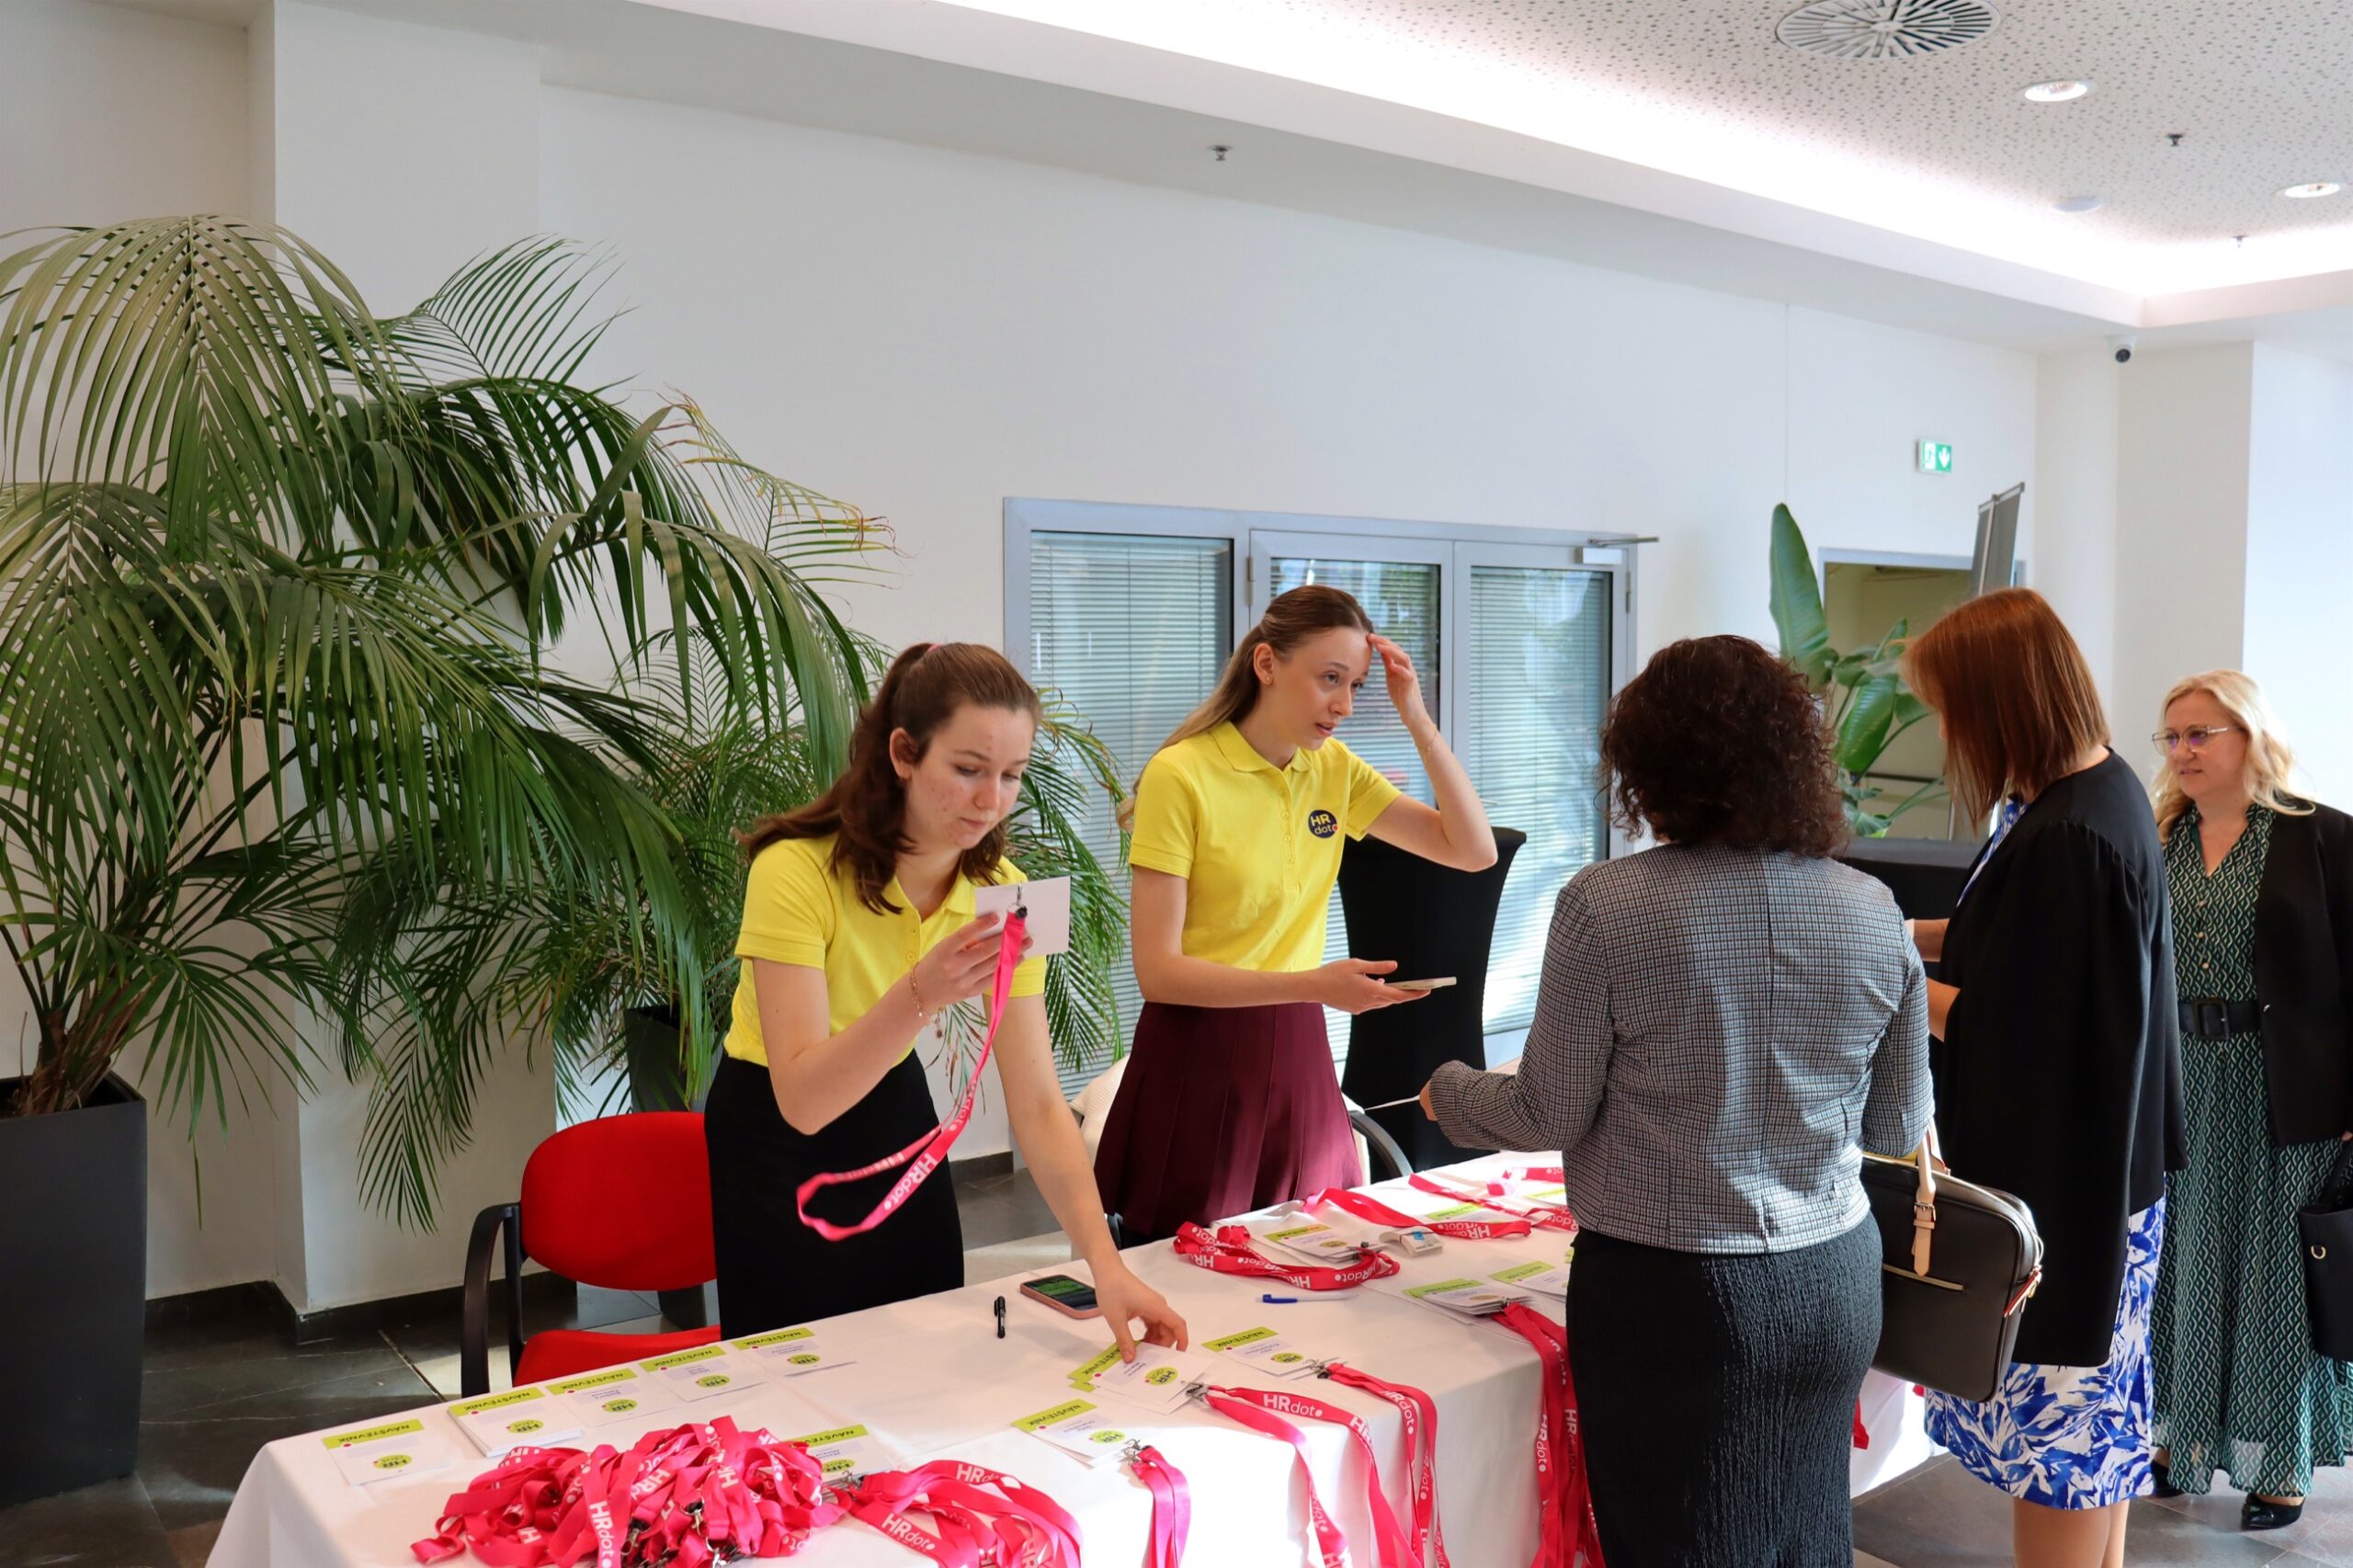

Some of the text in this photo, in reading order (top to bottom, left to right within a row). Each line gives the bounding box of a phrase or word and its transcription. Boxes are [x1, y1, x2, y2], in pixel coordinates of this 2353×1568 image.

[1310, 813, 1331, 826] HR
[1314, 824, 1332, 835] dot
[891, 1153, 938, 1205] HRdot
[1342, 1264, 1376, 1282] HRdot
[561, 1373, 623, 1390] NÁVŠTEVNÍK
[1155, 1370, 1175, 1383] HR
[463, 1392, 530, 1411] NÁVŠTEVNÍK
[612, 1403, 633, 1412] HR
[1264, 1394, 1316, 1416] HRdot
[338, 1425, 410, 1443] NÁVŠTEVNÍK
[517, 1424, 540, 1433] HR
[1536, 1414, 1548, 1463] HRdot
[382, 1459, 408, 1468] HR
[826, 1463, 851, 1472] HR
[631, 1468, 671, 1500] HRd
[589, 1500, 615, 1557] HRdot
[881, 1513, 930, 1548] HRdot
